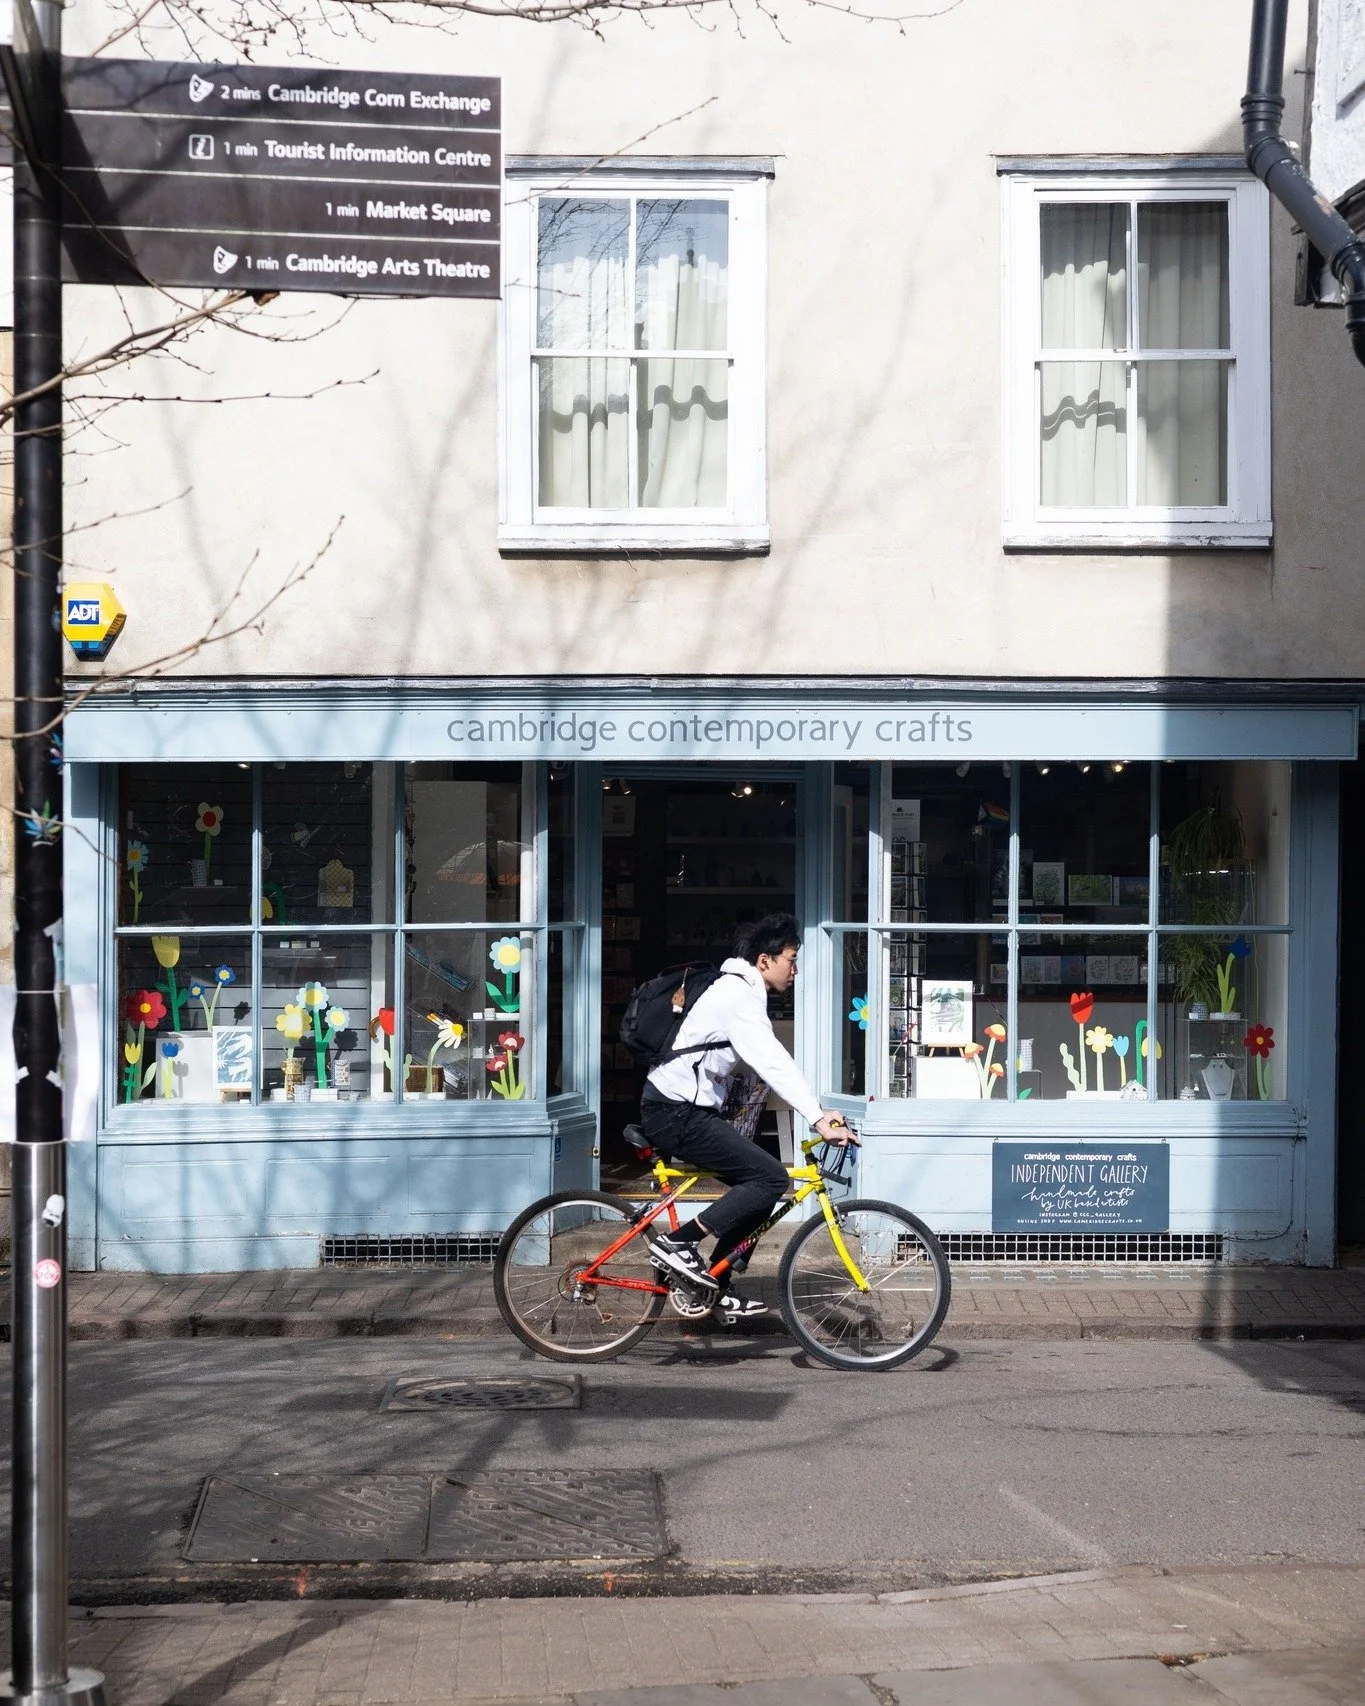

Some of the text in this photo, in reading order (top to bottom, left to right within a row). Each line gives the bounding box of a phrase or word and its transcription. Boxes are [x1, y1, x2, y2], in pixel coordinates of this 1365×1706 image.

[221, 84, 491, 116] 2 mins Cambridge Corn Exchange
[224, 139, 492, 167] 1 min Tourist Information Centre
[325, 200, 491, 225] 1 min Market Square
[245, 253, 491, 279] 1 min Cambridge Arts Theatre
[67, 603, 100, 621] ADT
[446, 712, 974, 751] cambridge contemporary crafts
[1023, 1152, 1137, 1162] cambridge contemporary crafts
[1011, 1163, 1148, 1184] INDEPENDENT GALLERY
[1021, 1184, 1136, 1201] handmade crafts
[1041, 1199, 1055, 1212] by
[1057, 1200, 1072, 1210] UK
